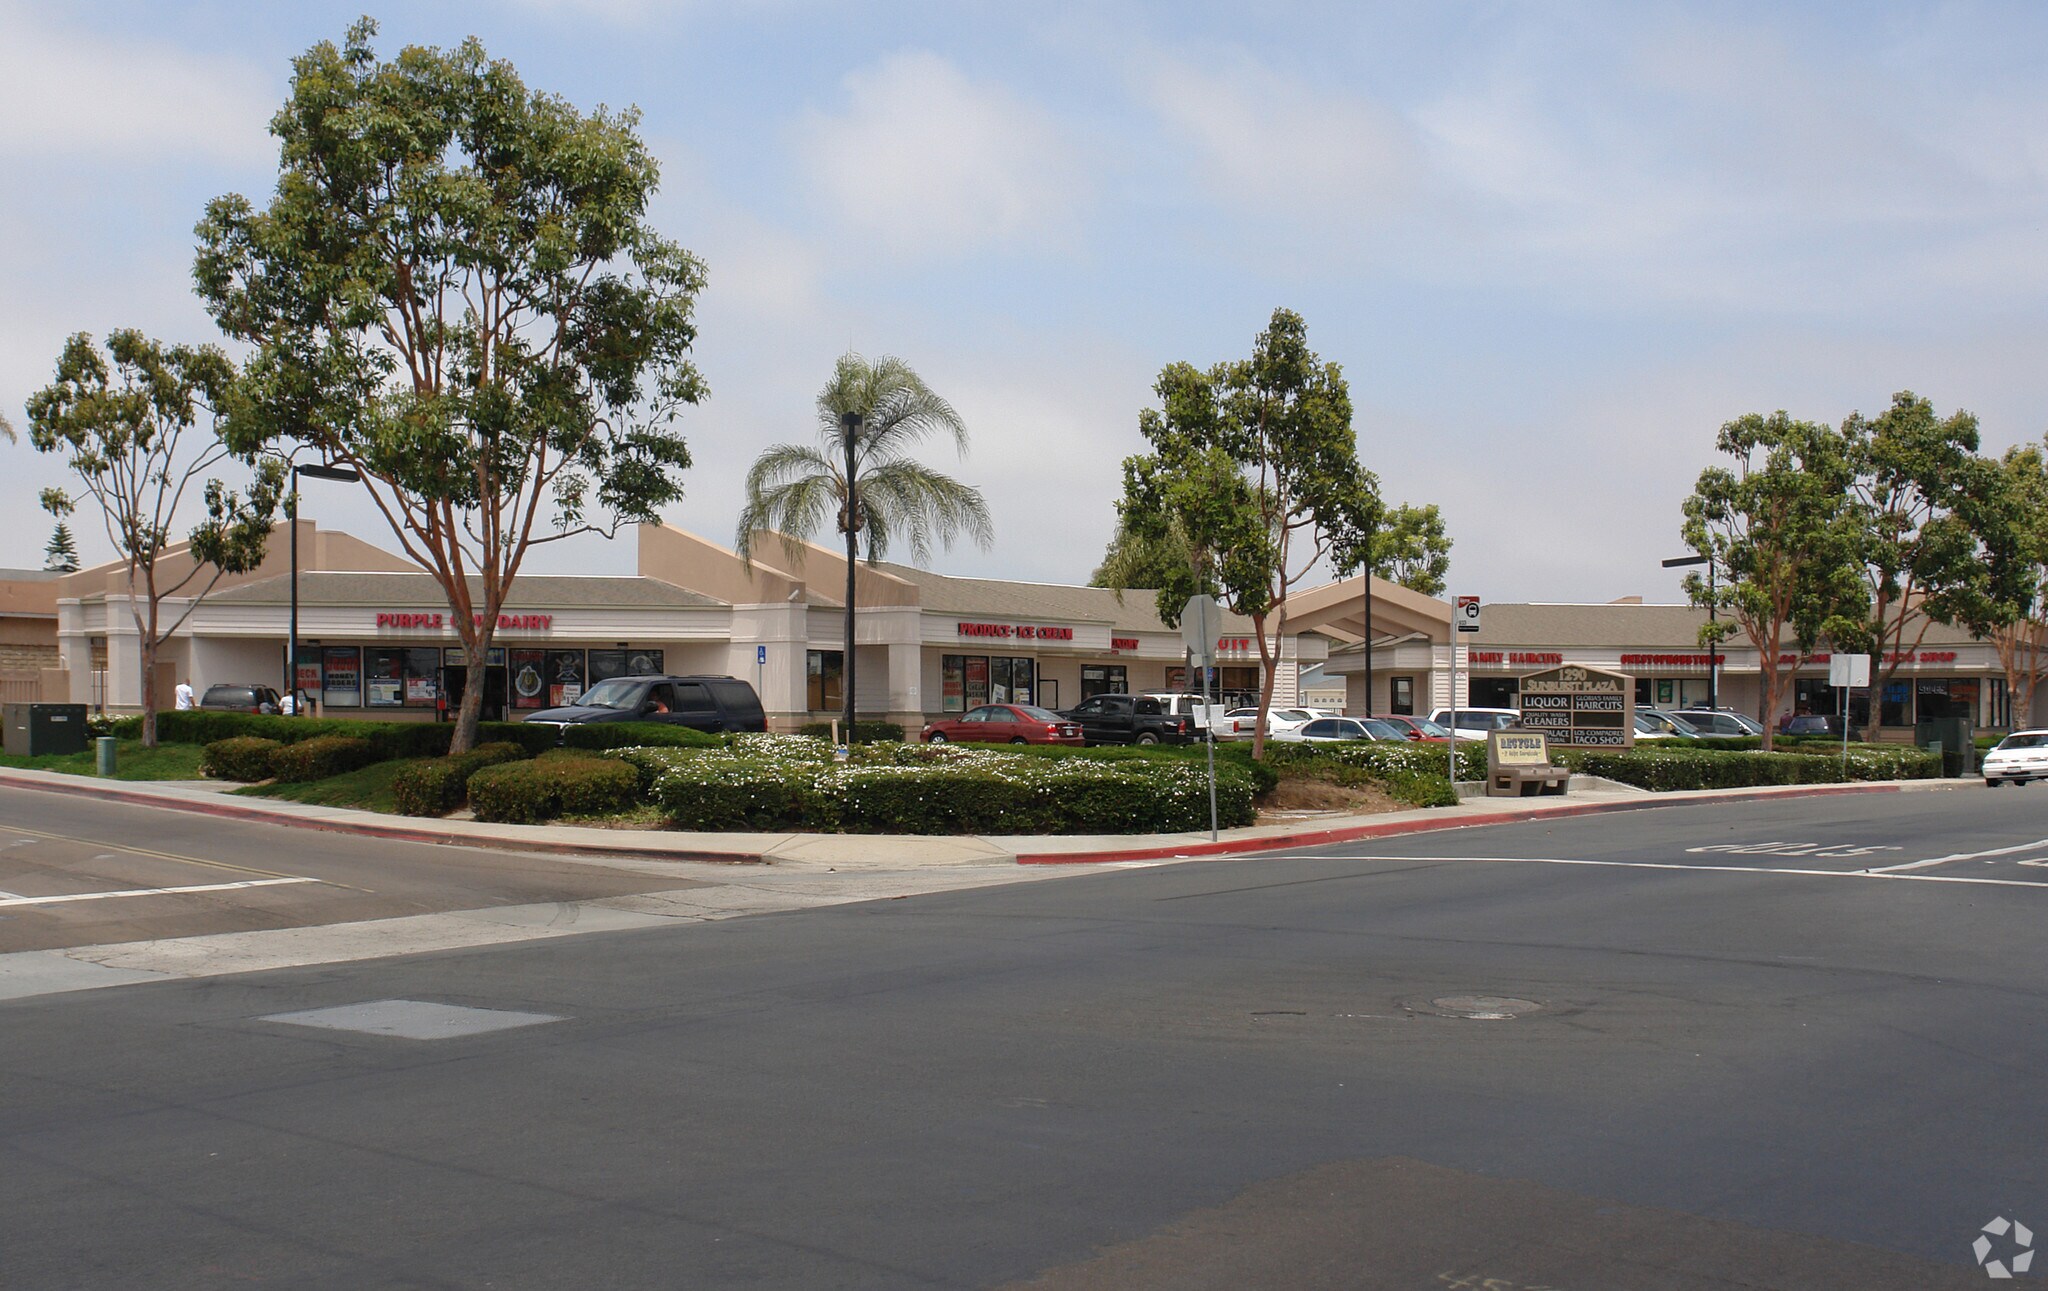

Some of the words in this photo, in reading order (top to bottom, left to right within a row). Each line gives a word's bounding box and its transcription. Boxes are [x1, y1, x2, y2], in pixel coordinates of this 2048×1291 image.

[376, 613, 443, 628] PURPLE
[498, 615, 552, 629] DAIRY
[958, 623, 1011, 638] PRODUCE
[1016, 626, 1035, 639] ICE
[1036, 627, 1073, 640] CREAM
[1216, 639, 1250, 650] UIT
[1469, 652, 1504, 663] FAMILY
[1509, 652, 1563, 664] HAIRCUTS
[1779, 654, 1797, 664] OS
[1920, 652, 1957, 663] SHOP
[1559, 668, 1587, 681] 1290
[1527, 680, 1581, 691] SUNBURST
[1583, 680, 1618, 691] PLAZA
[1525, 697, 1568, 708] LIQUOR
[1576, 701, 1623, 710] HAIRCUTS
[1523, 718, 1569, 726] CLEANERS
[1500, 738, 1541, 749] RECYCLE
[1574, 736, 1598, 744] TACO
[1599, 736, 1624, 744] SHOP
